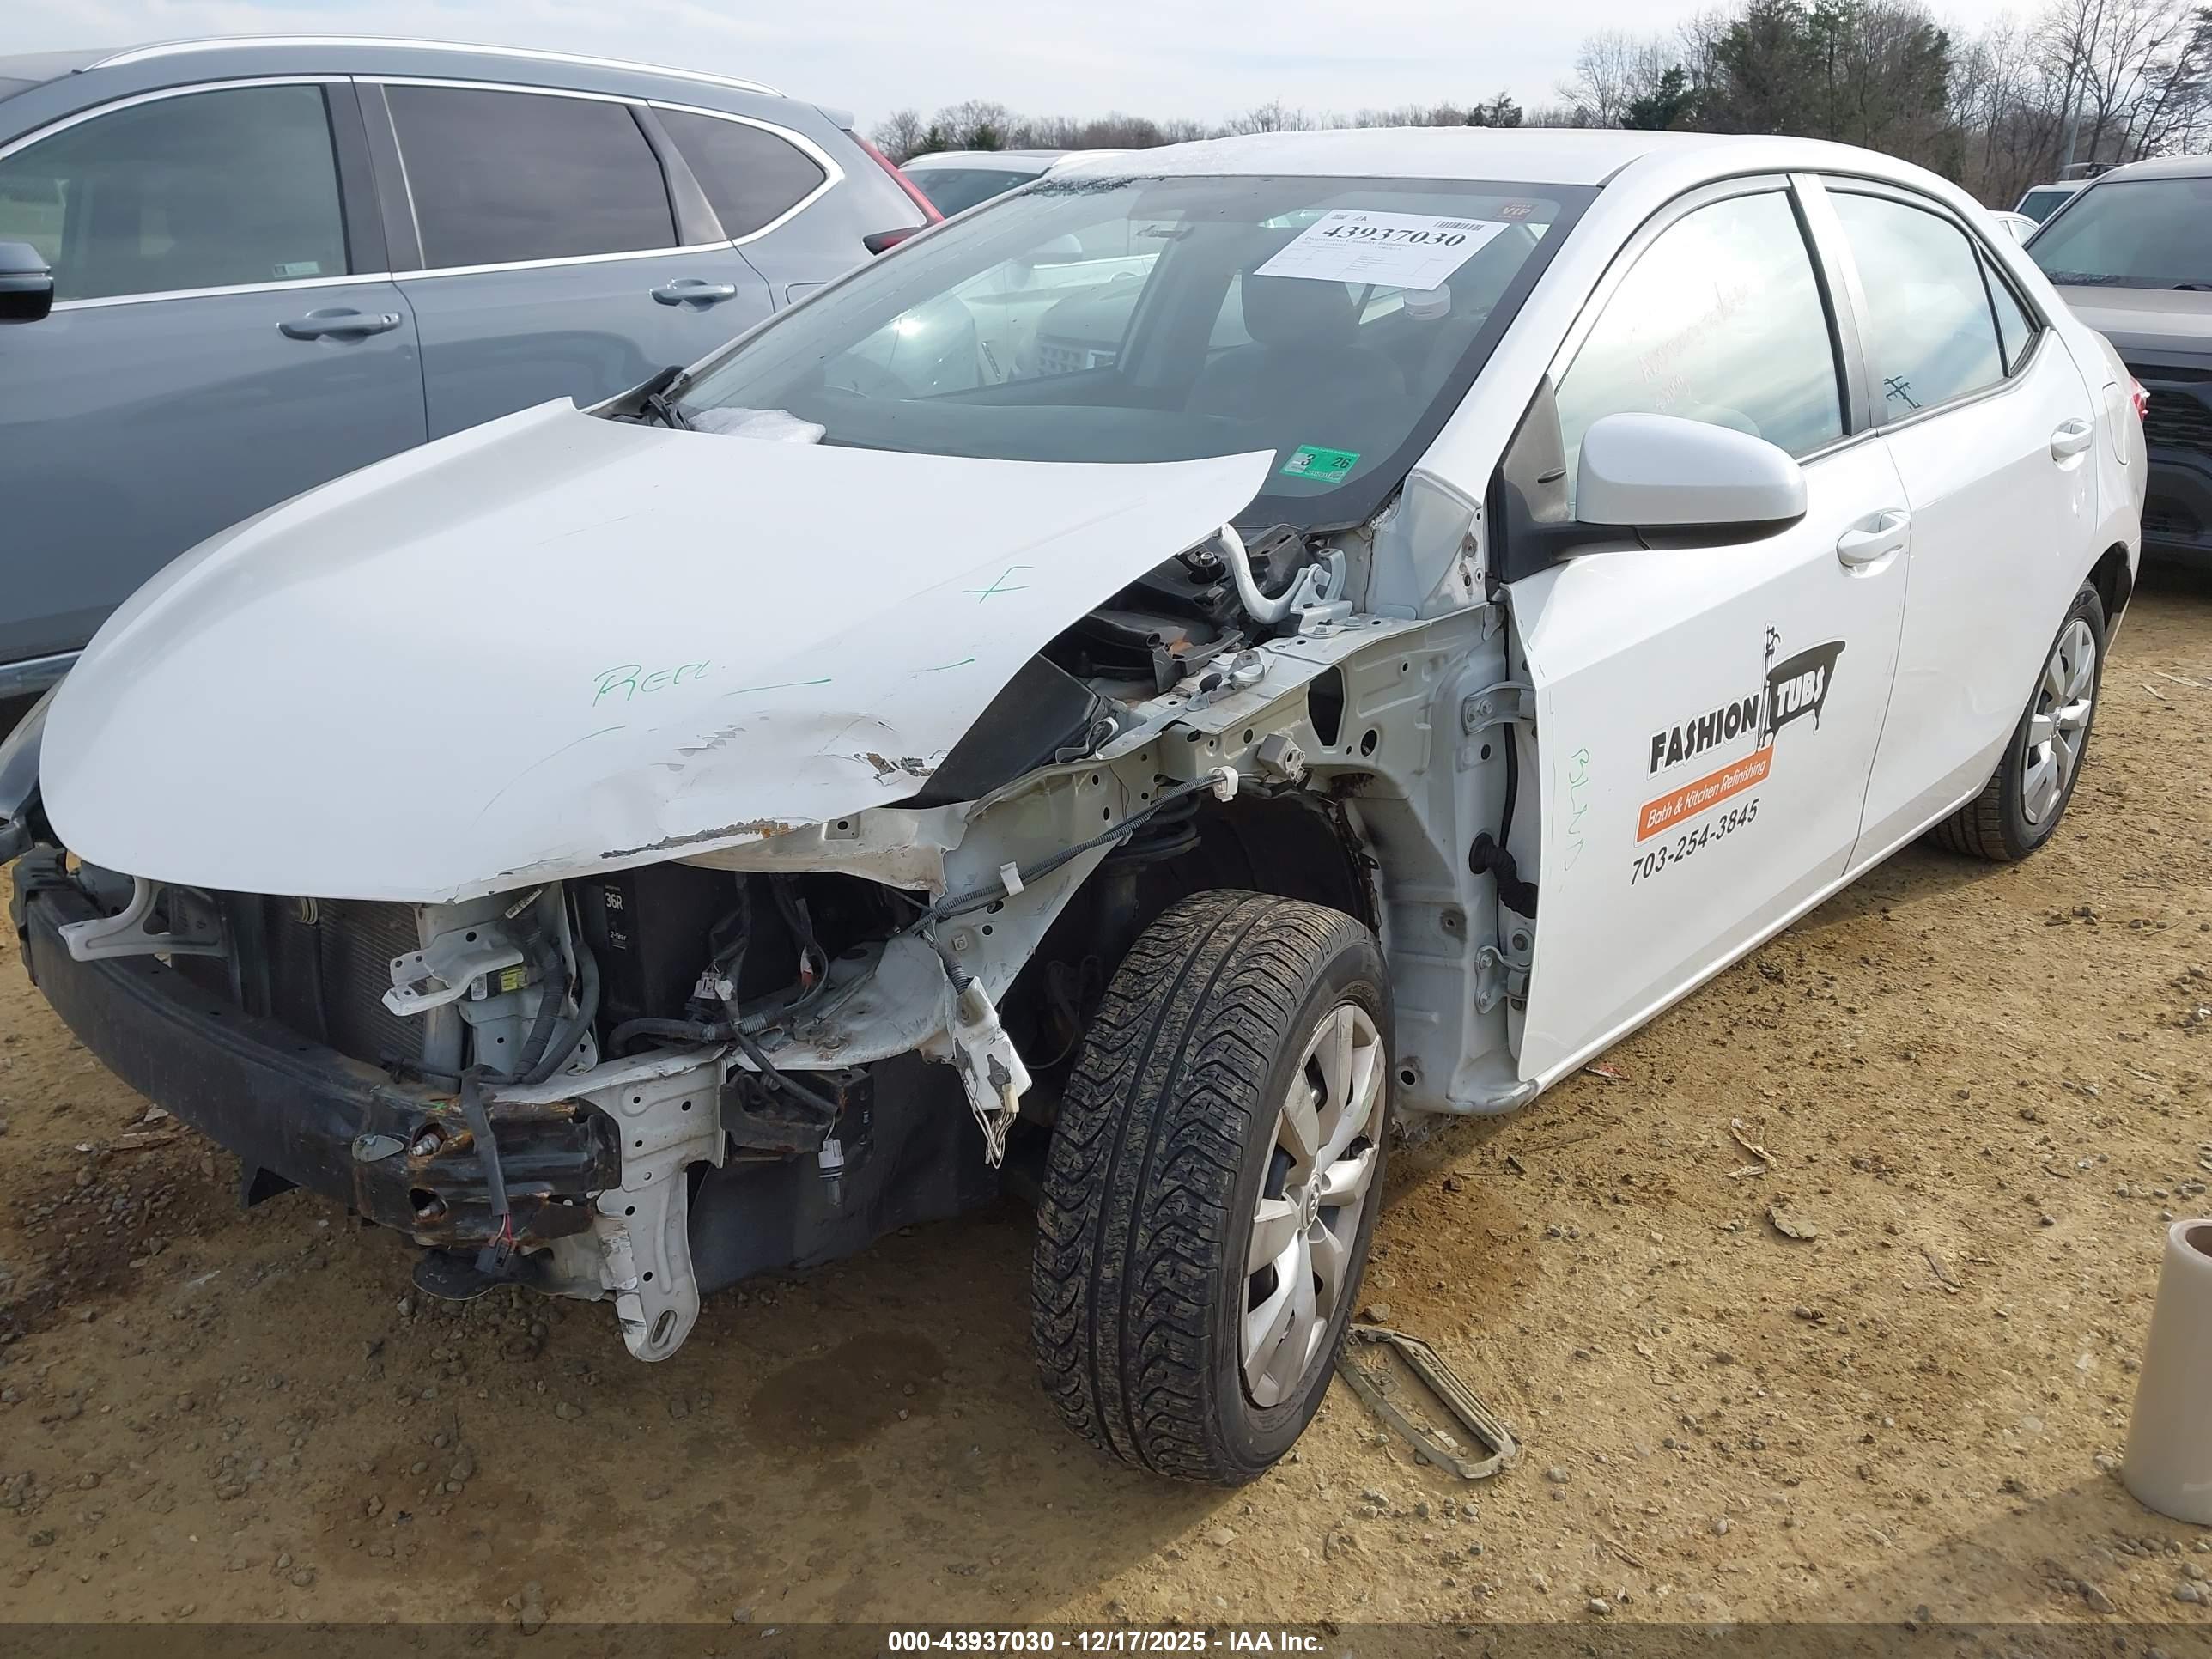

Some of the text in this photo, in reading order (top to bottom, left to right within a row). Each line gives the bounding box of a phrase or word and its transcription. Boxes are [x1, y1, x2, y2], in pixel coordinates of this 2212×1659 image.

[1323, 225, 1466, 246] 43937030
[1301, 453, 1352, 469] 3 26
[1650, 664, 1826, 774] FASHION TUBS
[1646, 759, 1766, 830] Bath & Kitchen Refinishing
[1631, 797, 1760, 886] 703-254-3845
[605, 892, 623, 910] 36R
[611, 931, 627, 941] 2-Year
